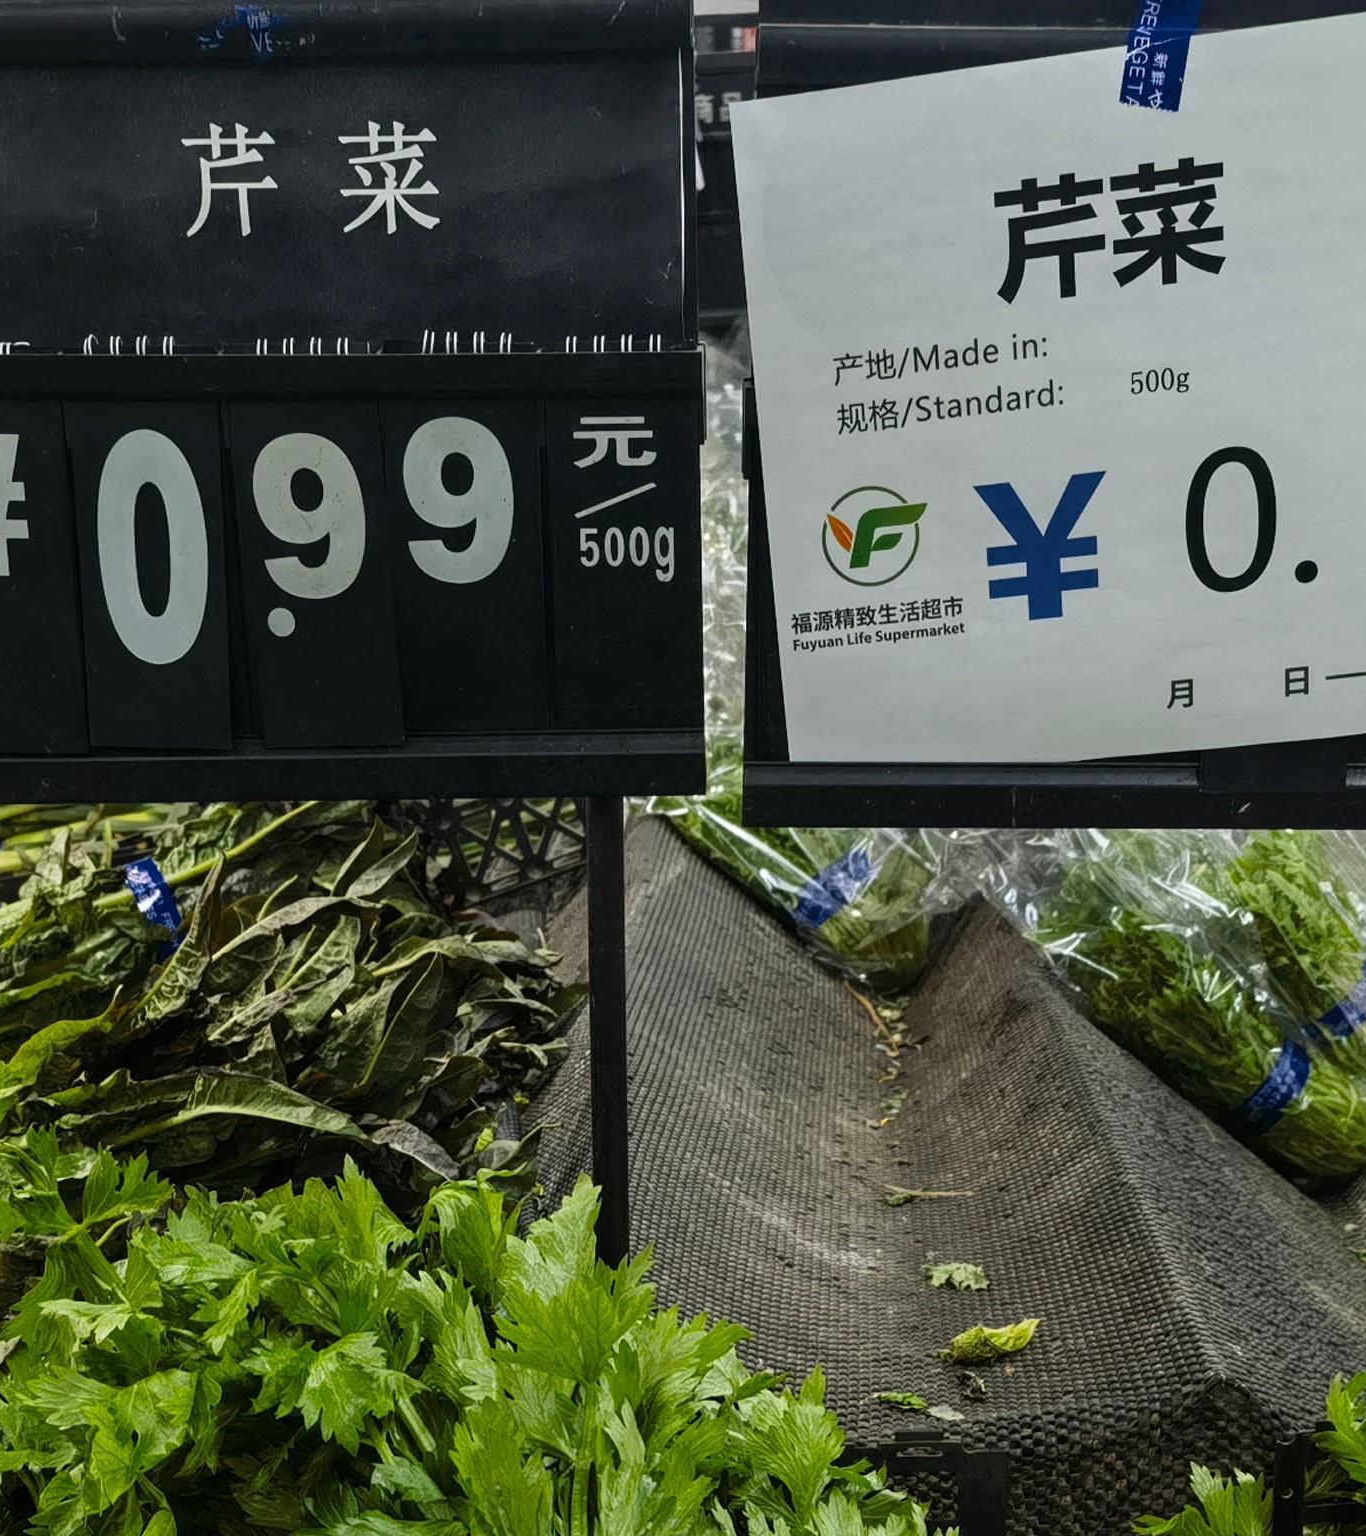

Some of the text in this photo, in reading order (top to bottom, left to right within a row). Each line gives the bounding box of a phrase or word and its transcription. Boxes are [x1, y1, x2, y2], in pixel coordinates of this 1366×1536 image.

[181, 120, 441, 238] 芹菜
[993, 156, 1227, 305] 芹菜
[833, 332, 1049, 387] 产地/Made in:
[1129, 366, 1191, 397] 500g
[837, 378, 1065, 436] 规格/Standard:
[572, 415, 658, 469] 元
[578, 525, 676, 584] 500g
[790, 595, 964, 636] 福源精致生活超市
[792, 621, 966, 653] Fuyuan Life Supermarket
[1166, 678, 1195, 710] 月
[1283, 665, 1310, 698] 日
